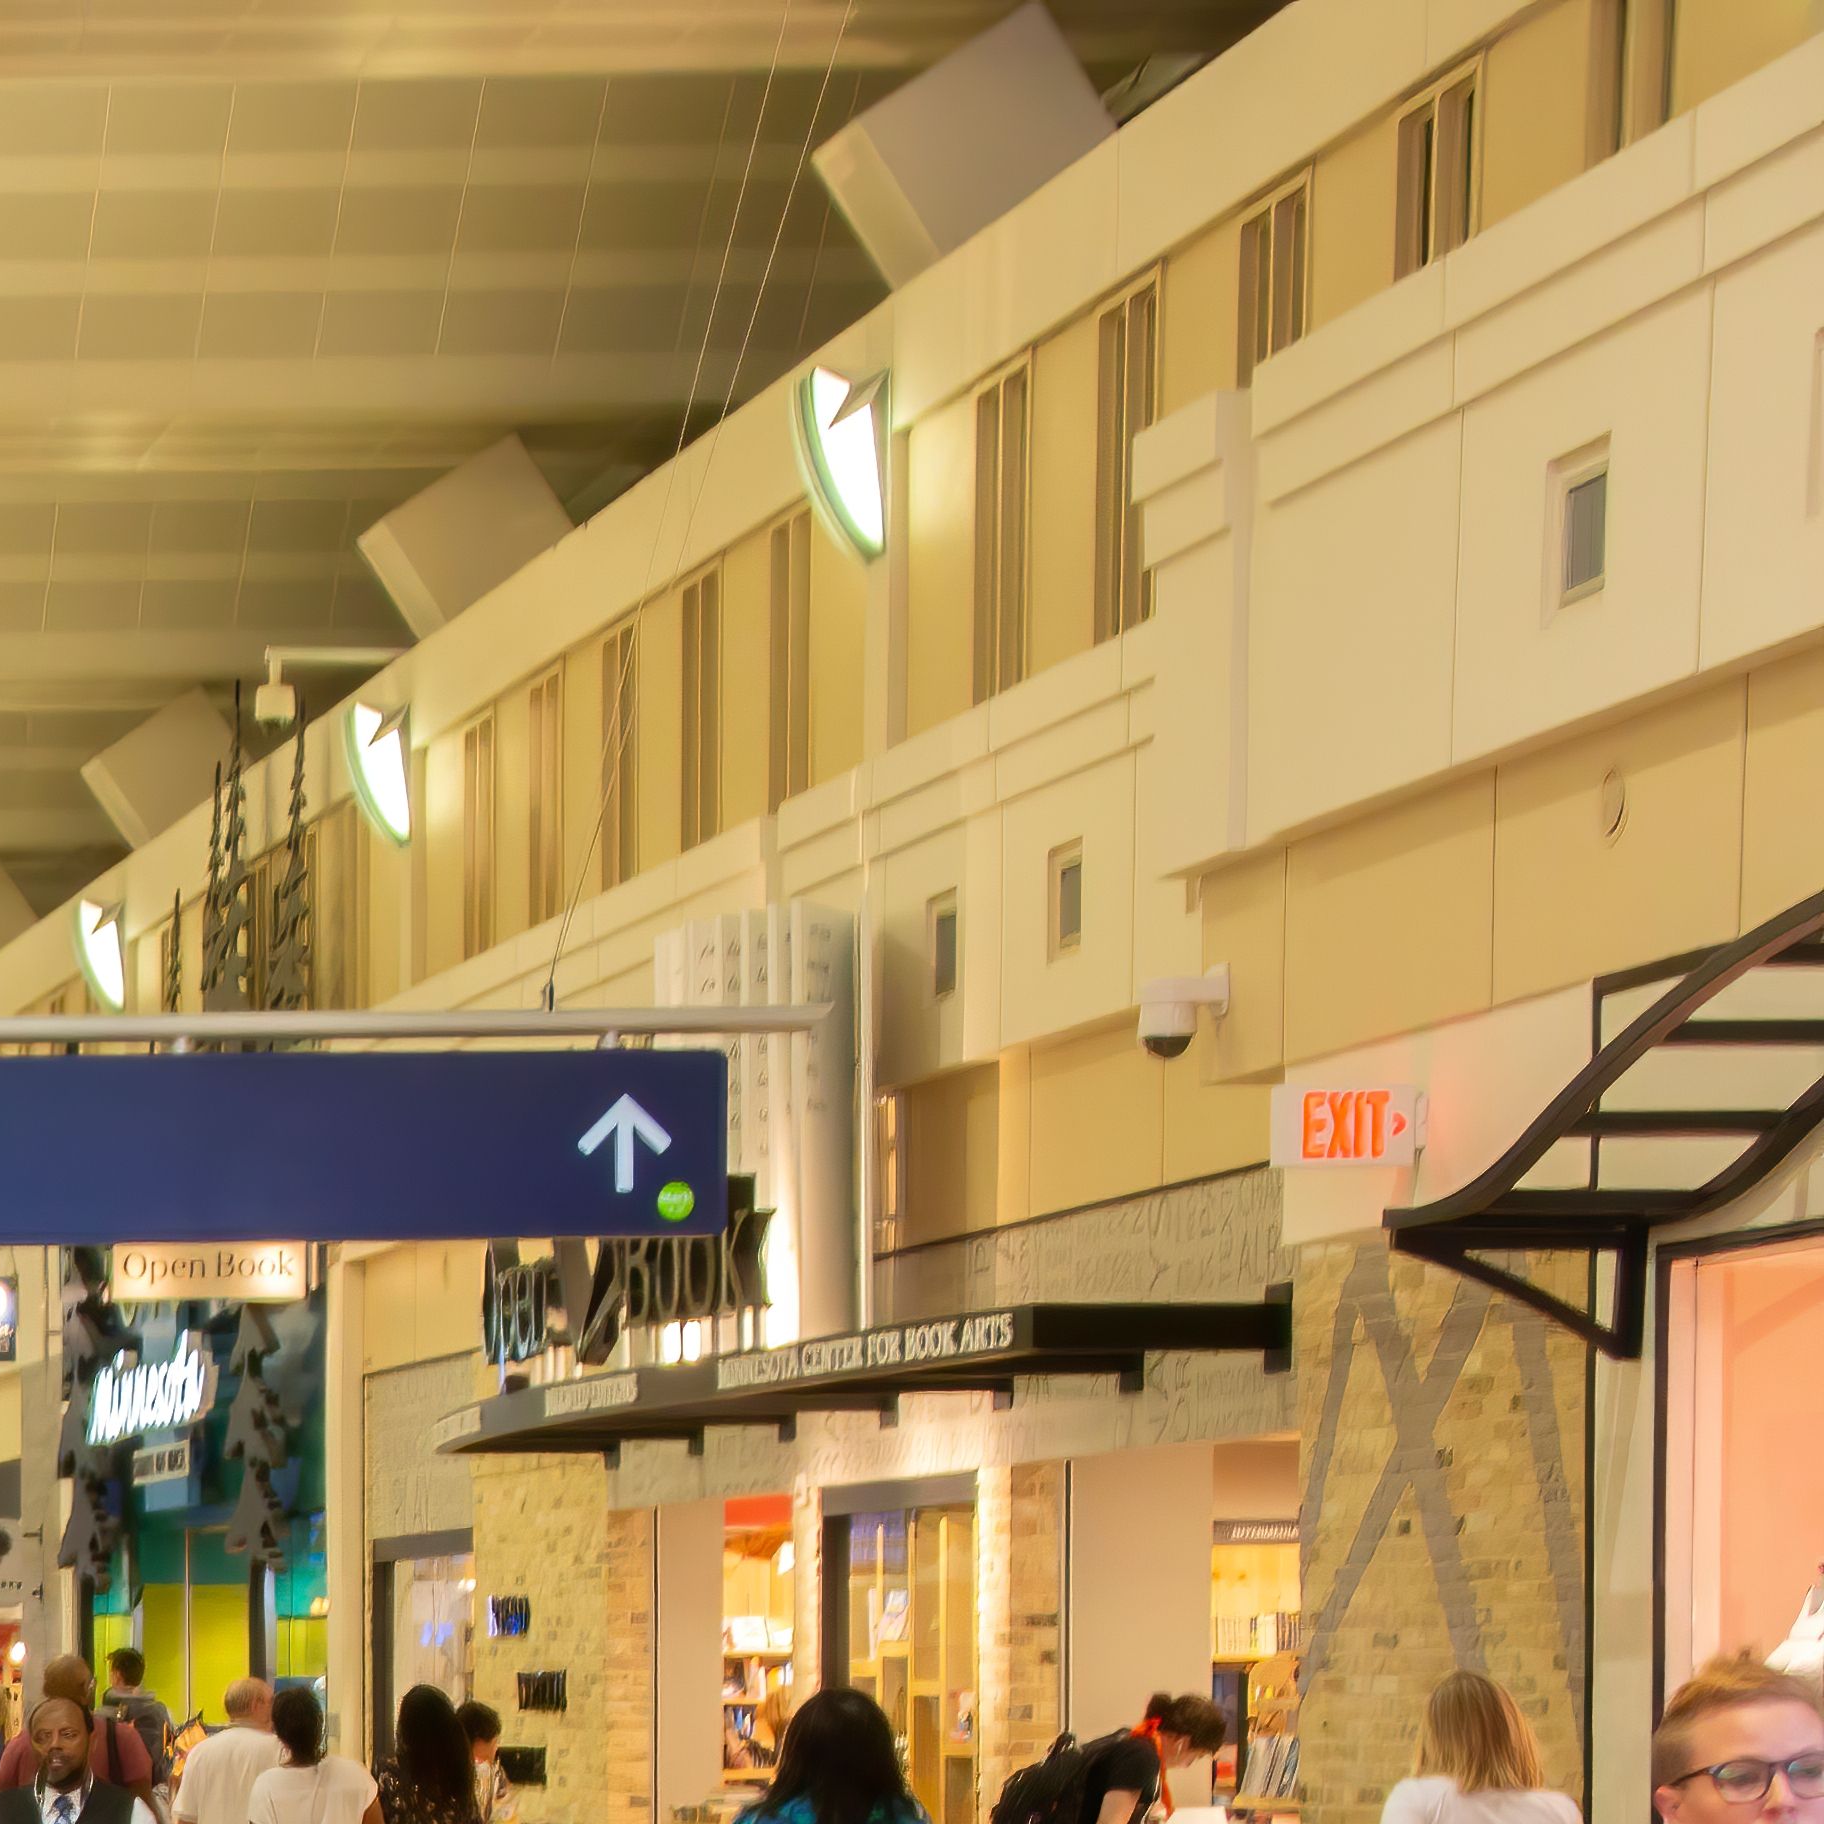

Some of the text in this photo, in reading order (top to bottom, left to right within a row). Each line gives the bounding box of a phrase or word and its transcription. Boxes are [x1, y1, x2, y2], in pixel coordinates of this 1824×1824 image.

[1302, 1091, 1390, 1159] EXIT
[123, 1250, 295, 1285] Open Book
[866, 1330, 902, 1367] FOR
[905, 1321, 958, 1361] BOOK
[959, 1312, 1014, 1353] ARTS
[85, 1328, 205, 1445] Minnesota
